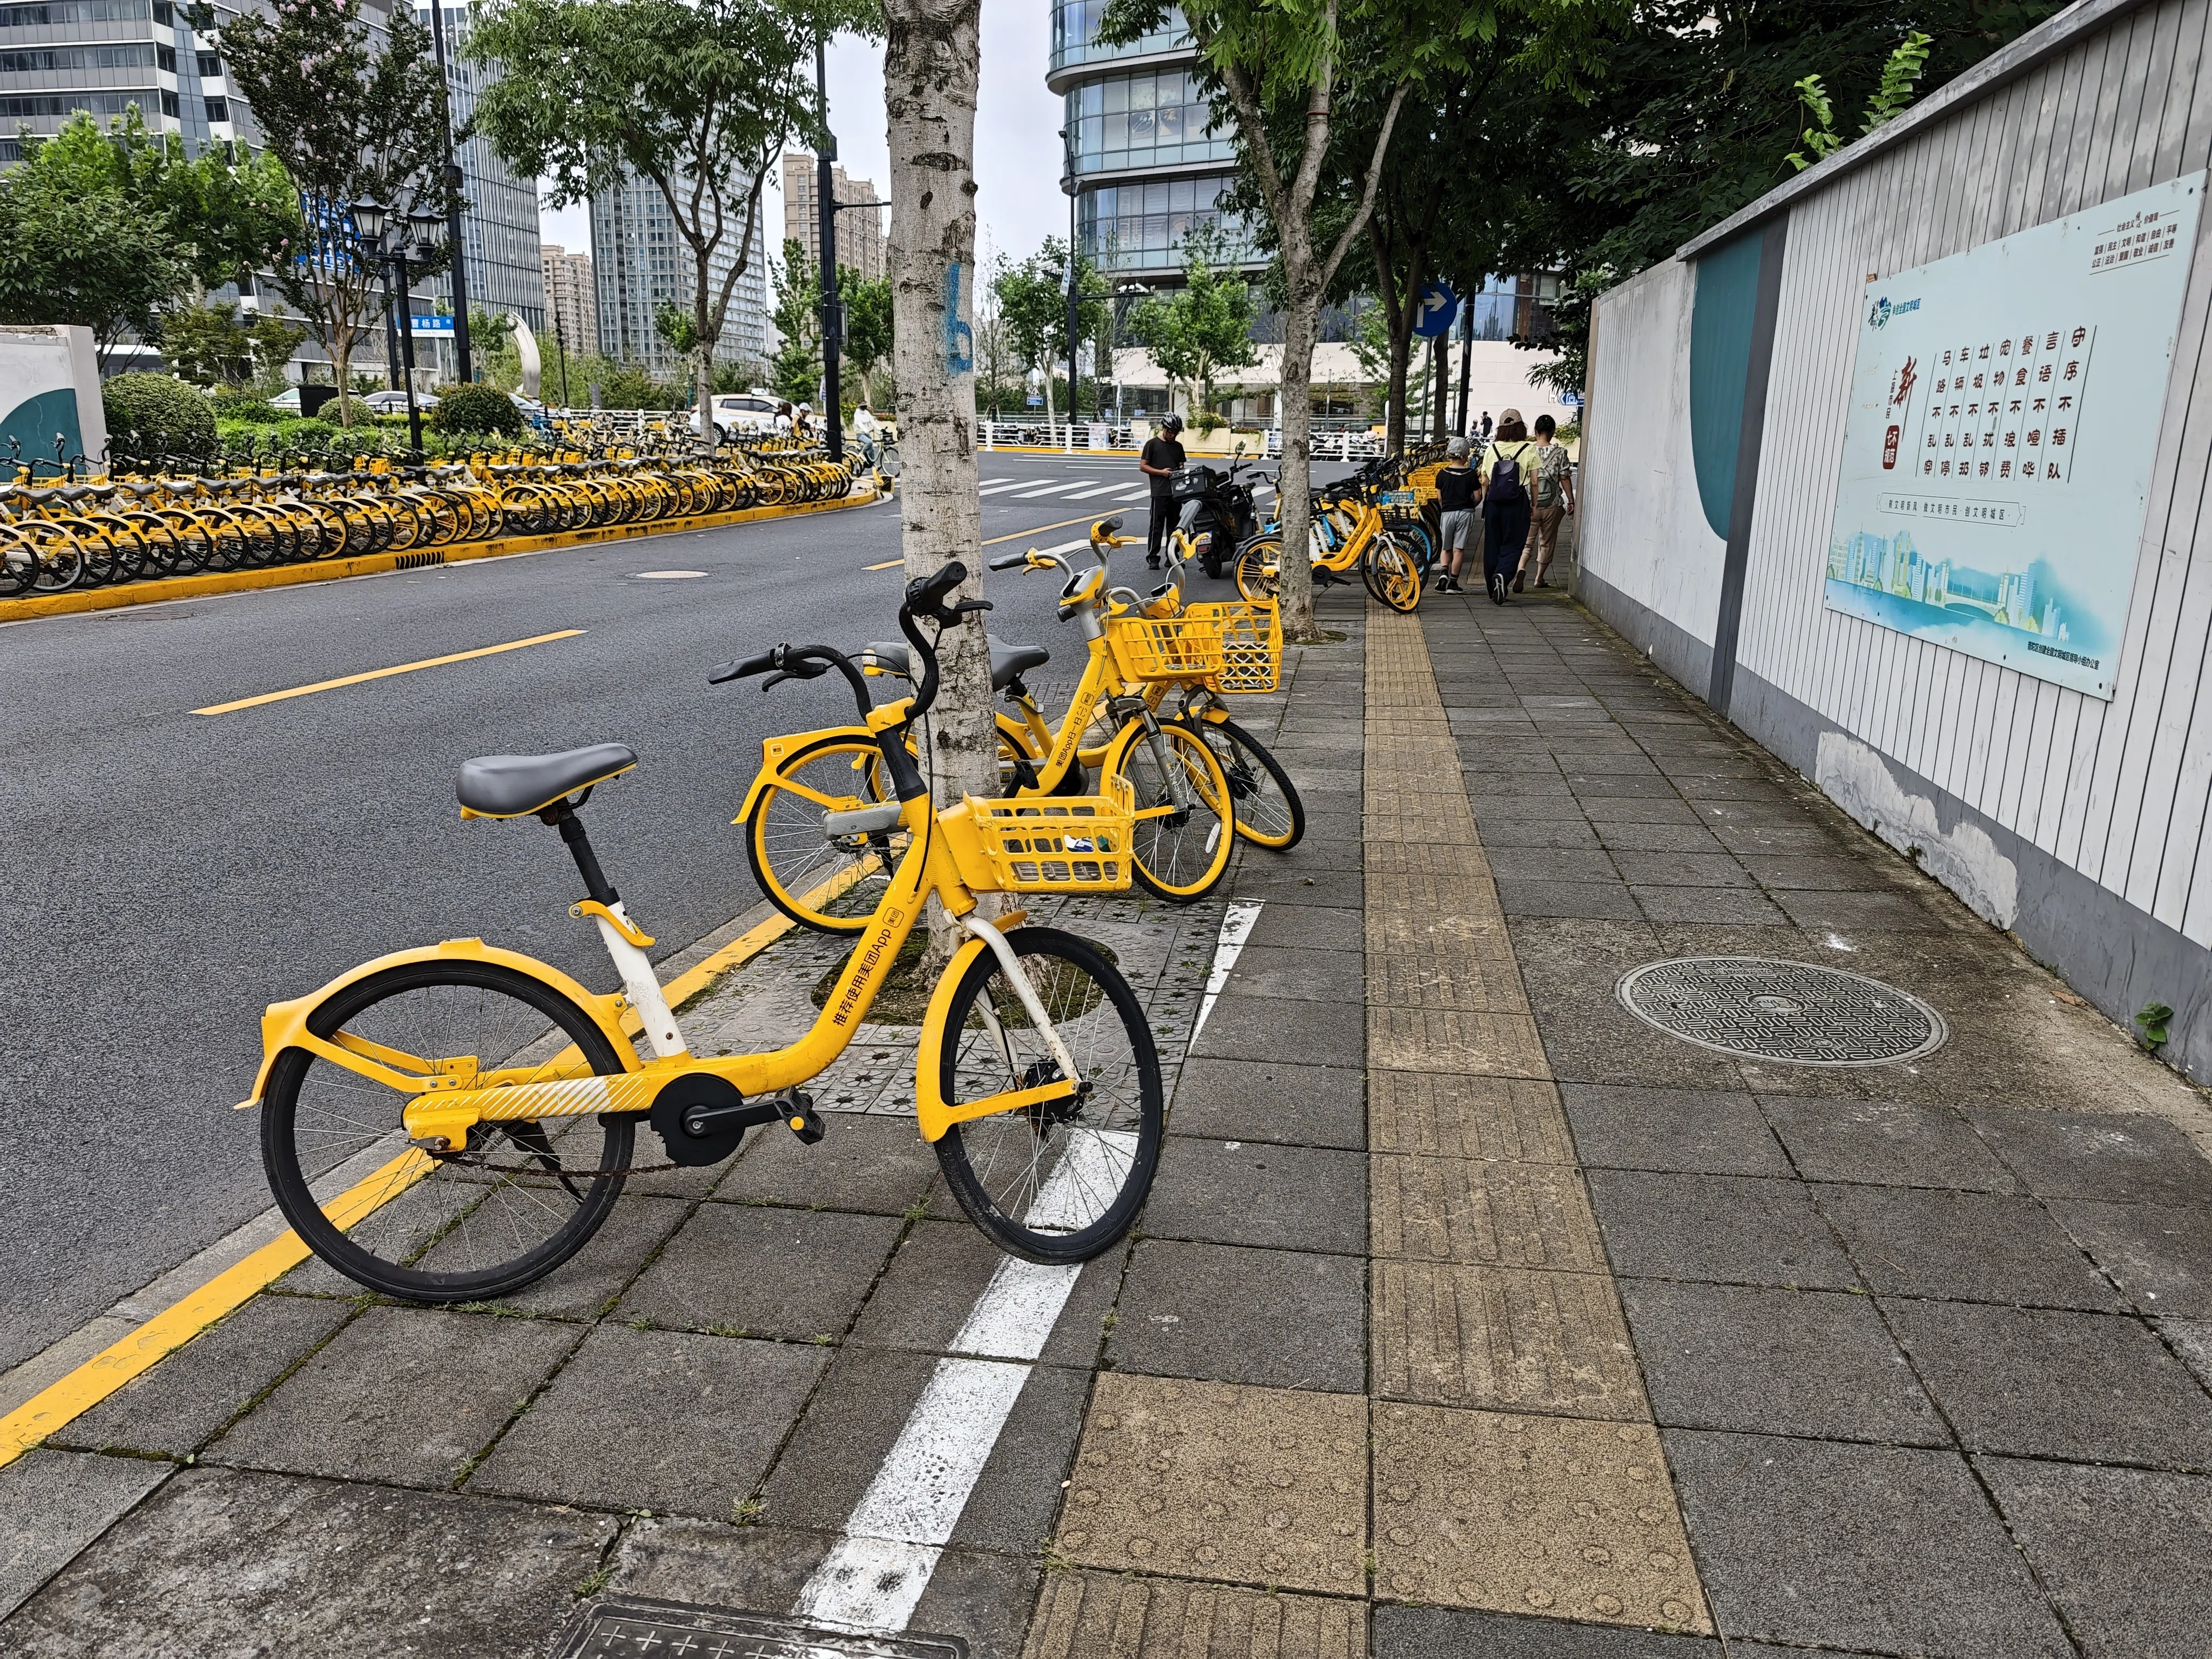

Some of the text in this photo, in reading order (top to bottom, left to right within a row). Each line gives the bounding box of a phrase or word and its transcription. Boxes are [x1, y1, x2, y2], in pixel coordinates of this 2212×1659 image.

[2150, 228, 2161, 240] 自由
[410, 319, 441, 328] 曹杨路
[1924, 350, 1952, 475] 马路不乱穿
[1940, 346, 1970, 477] 车辆不乱停
[1958, 343, 1990, 477] 垃圾不乱扔
[1979, 338, 2011, 478] 宠物不扰邻
[2000, 335, 2034, 478] 餐食不浪费
[2022, 331, 2060, 479] 言语不喧哗
[2047, 325, 2086, 481] 守序不插队
[1055, 717, 1082, 768] 美团App扫一扫
[832, 929, 893, 1027] 推荐使用美团App
